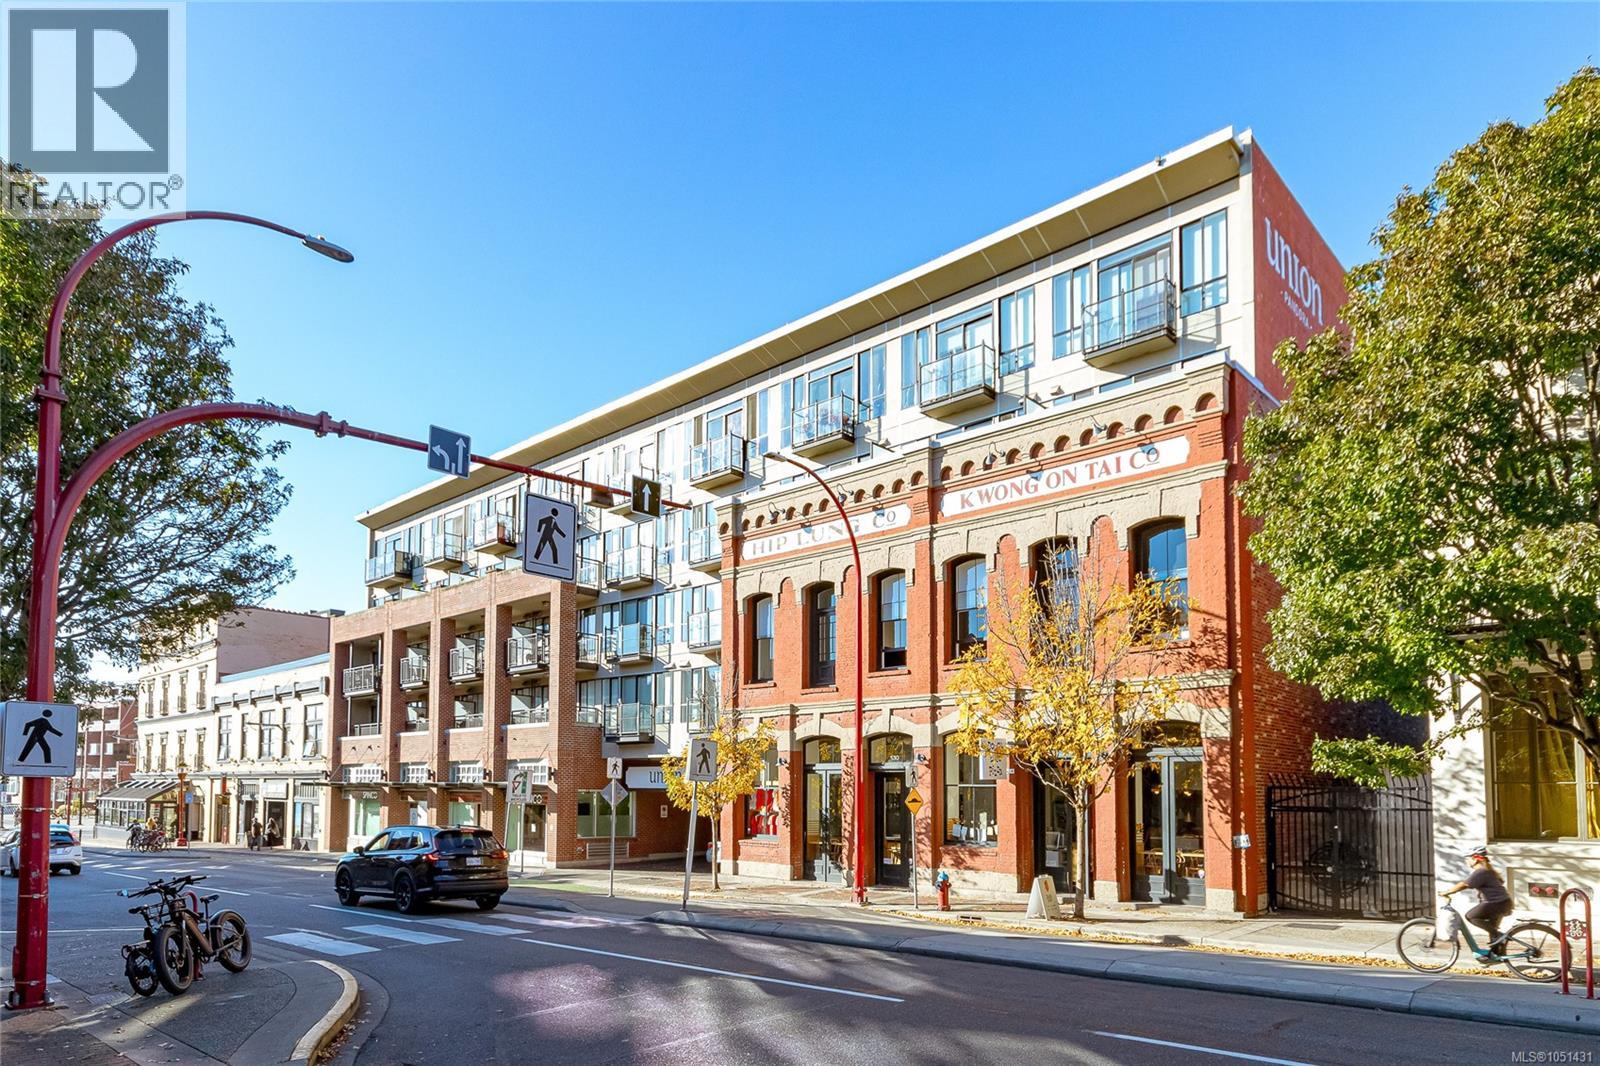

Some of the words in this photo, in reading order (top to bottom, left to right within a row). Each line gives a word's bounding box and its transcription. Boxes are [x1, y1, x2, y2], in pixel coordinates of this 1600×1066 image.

[960, 476, 1039, 510] KWONG
[1045, 466, 1077, 490] ON
[1085, 455, 1122, 480] TAI
[752, 535, 788, 556] HIP
